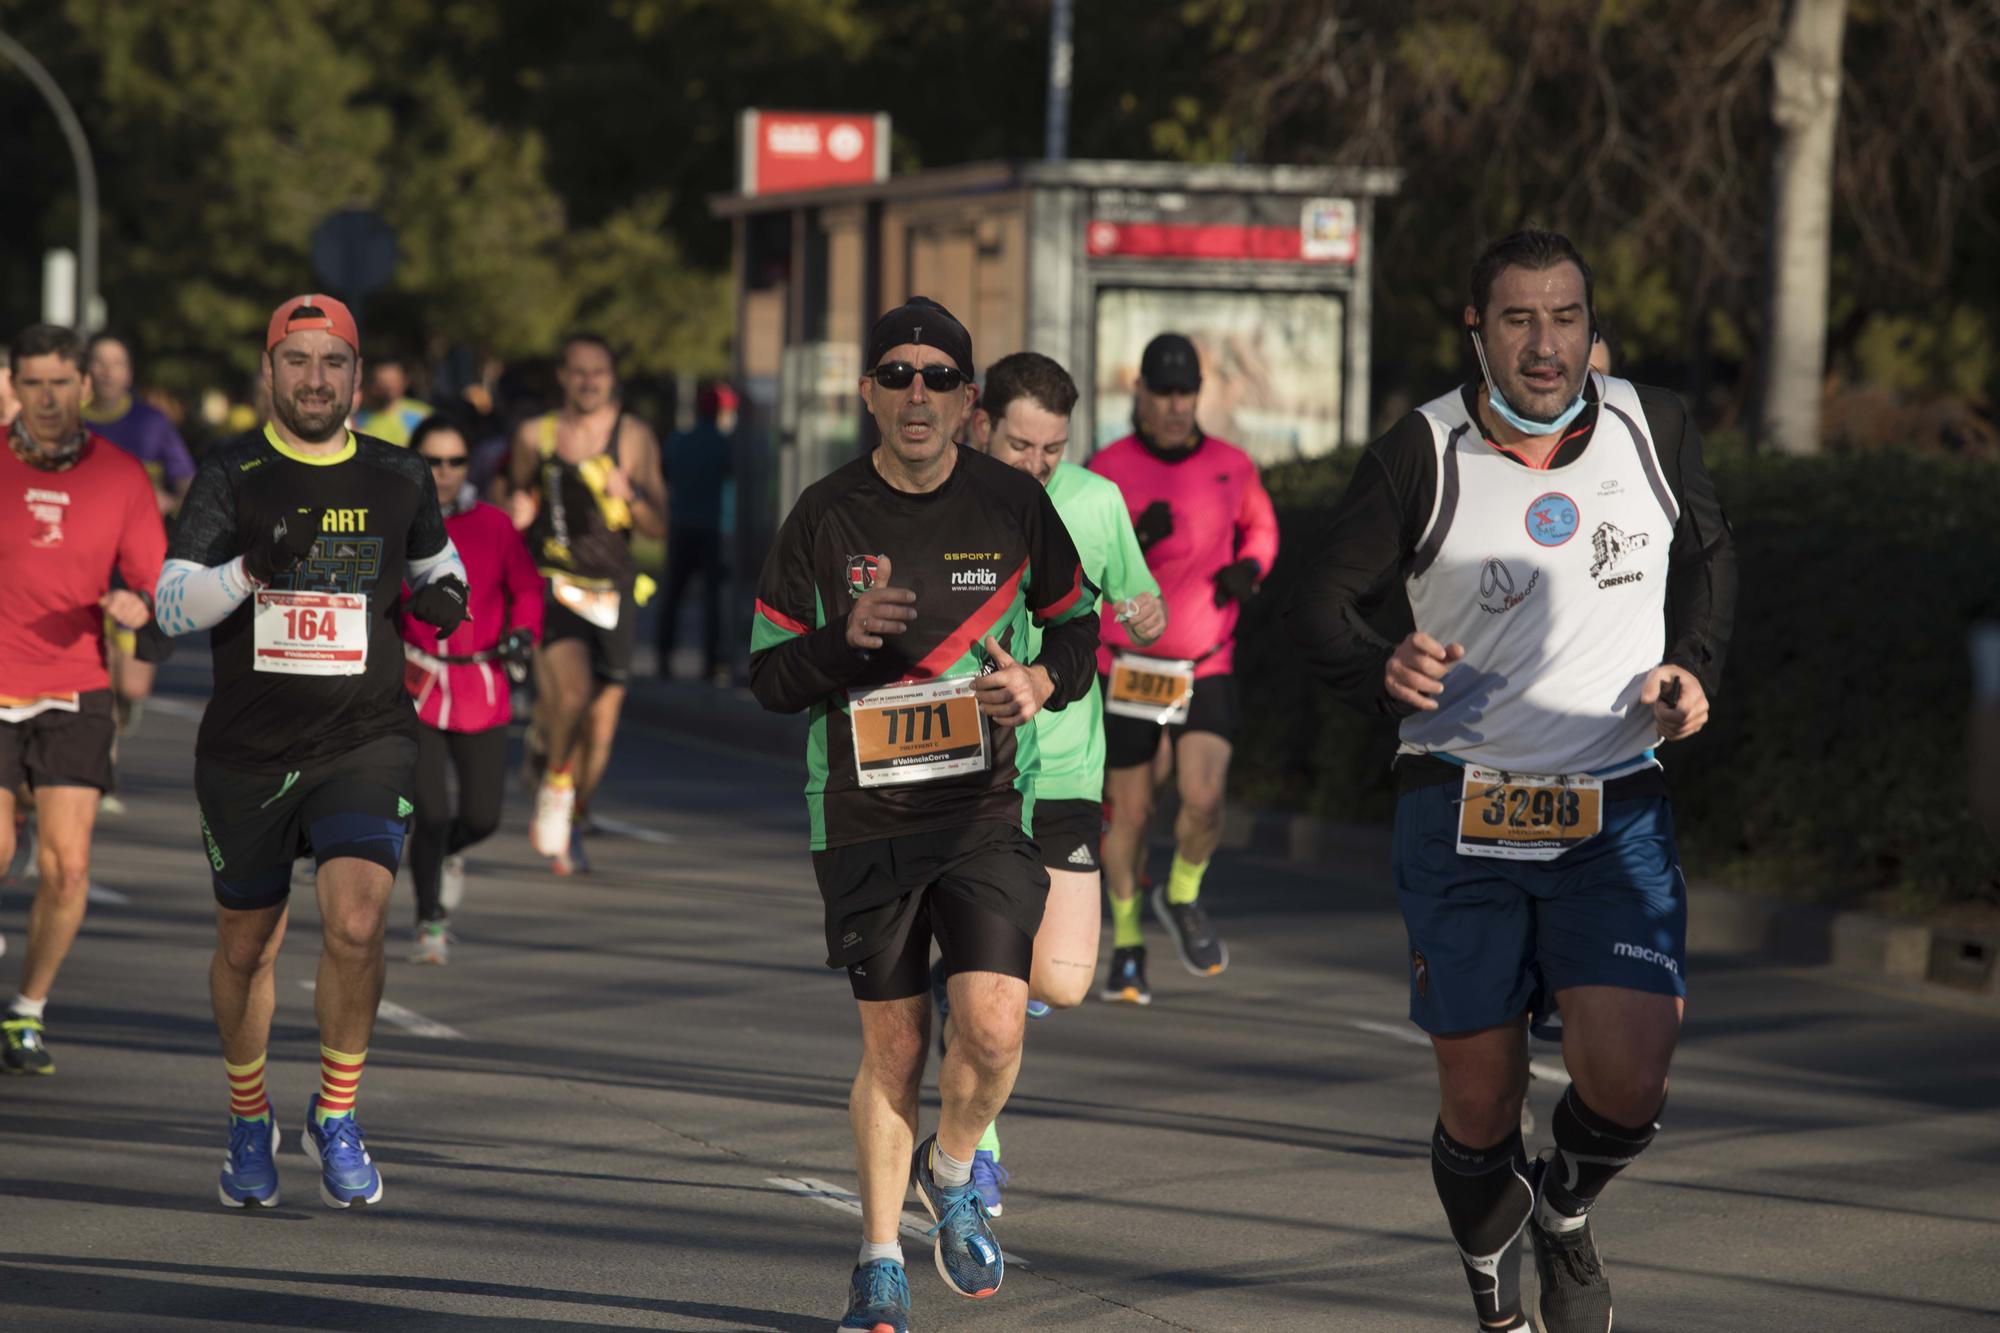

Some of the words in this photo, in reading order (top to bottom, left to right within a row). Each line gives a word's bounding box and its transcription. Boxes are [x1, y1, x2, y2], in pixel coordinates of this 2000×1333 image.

[297, 507, 369, 533] ART
[951, 568, 997, 586] nutrilia
[283, 608, 337, 641] 164
[881, 702, 951, 745] 7771
[1482, 787, 1580, 828] 3298
[1613, 942, 1678, 975] macron
